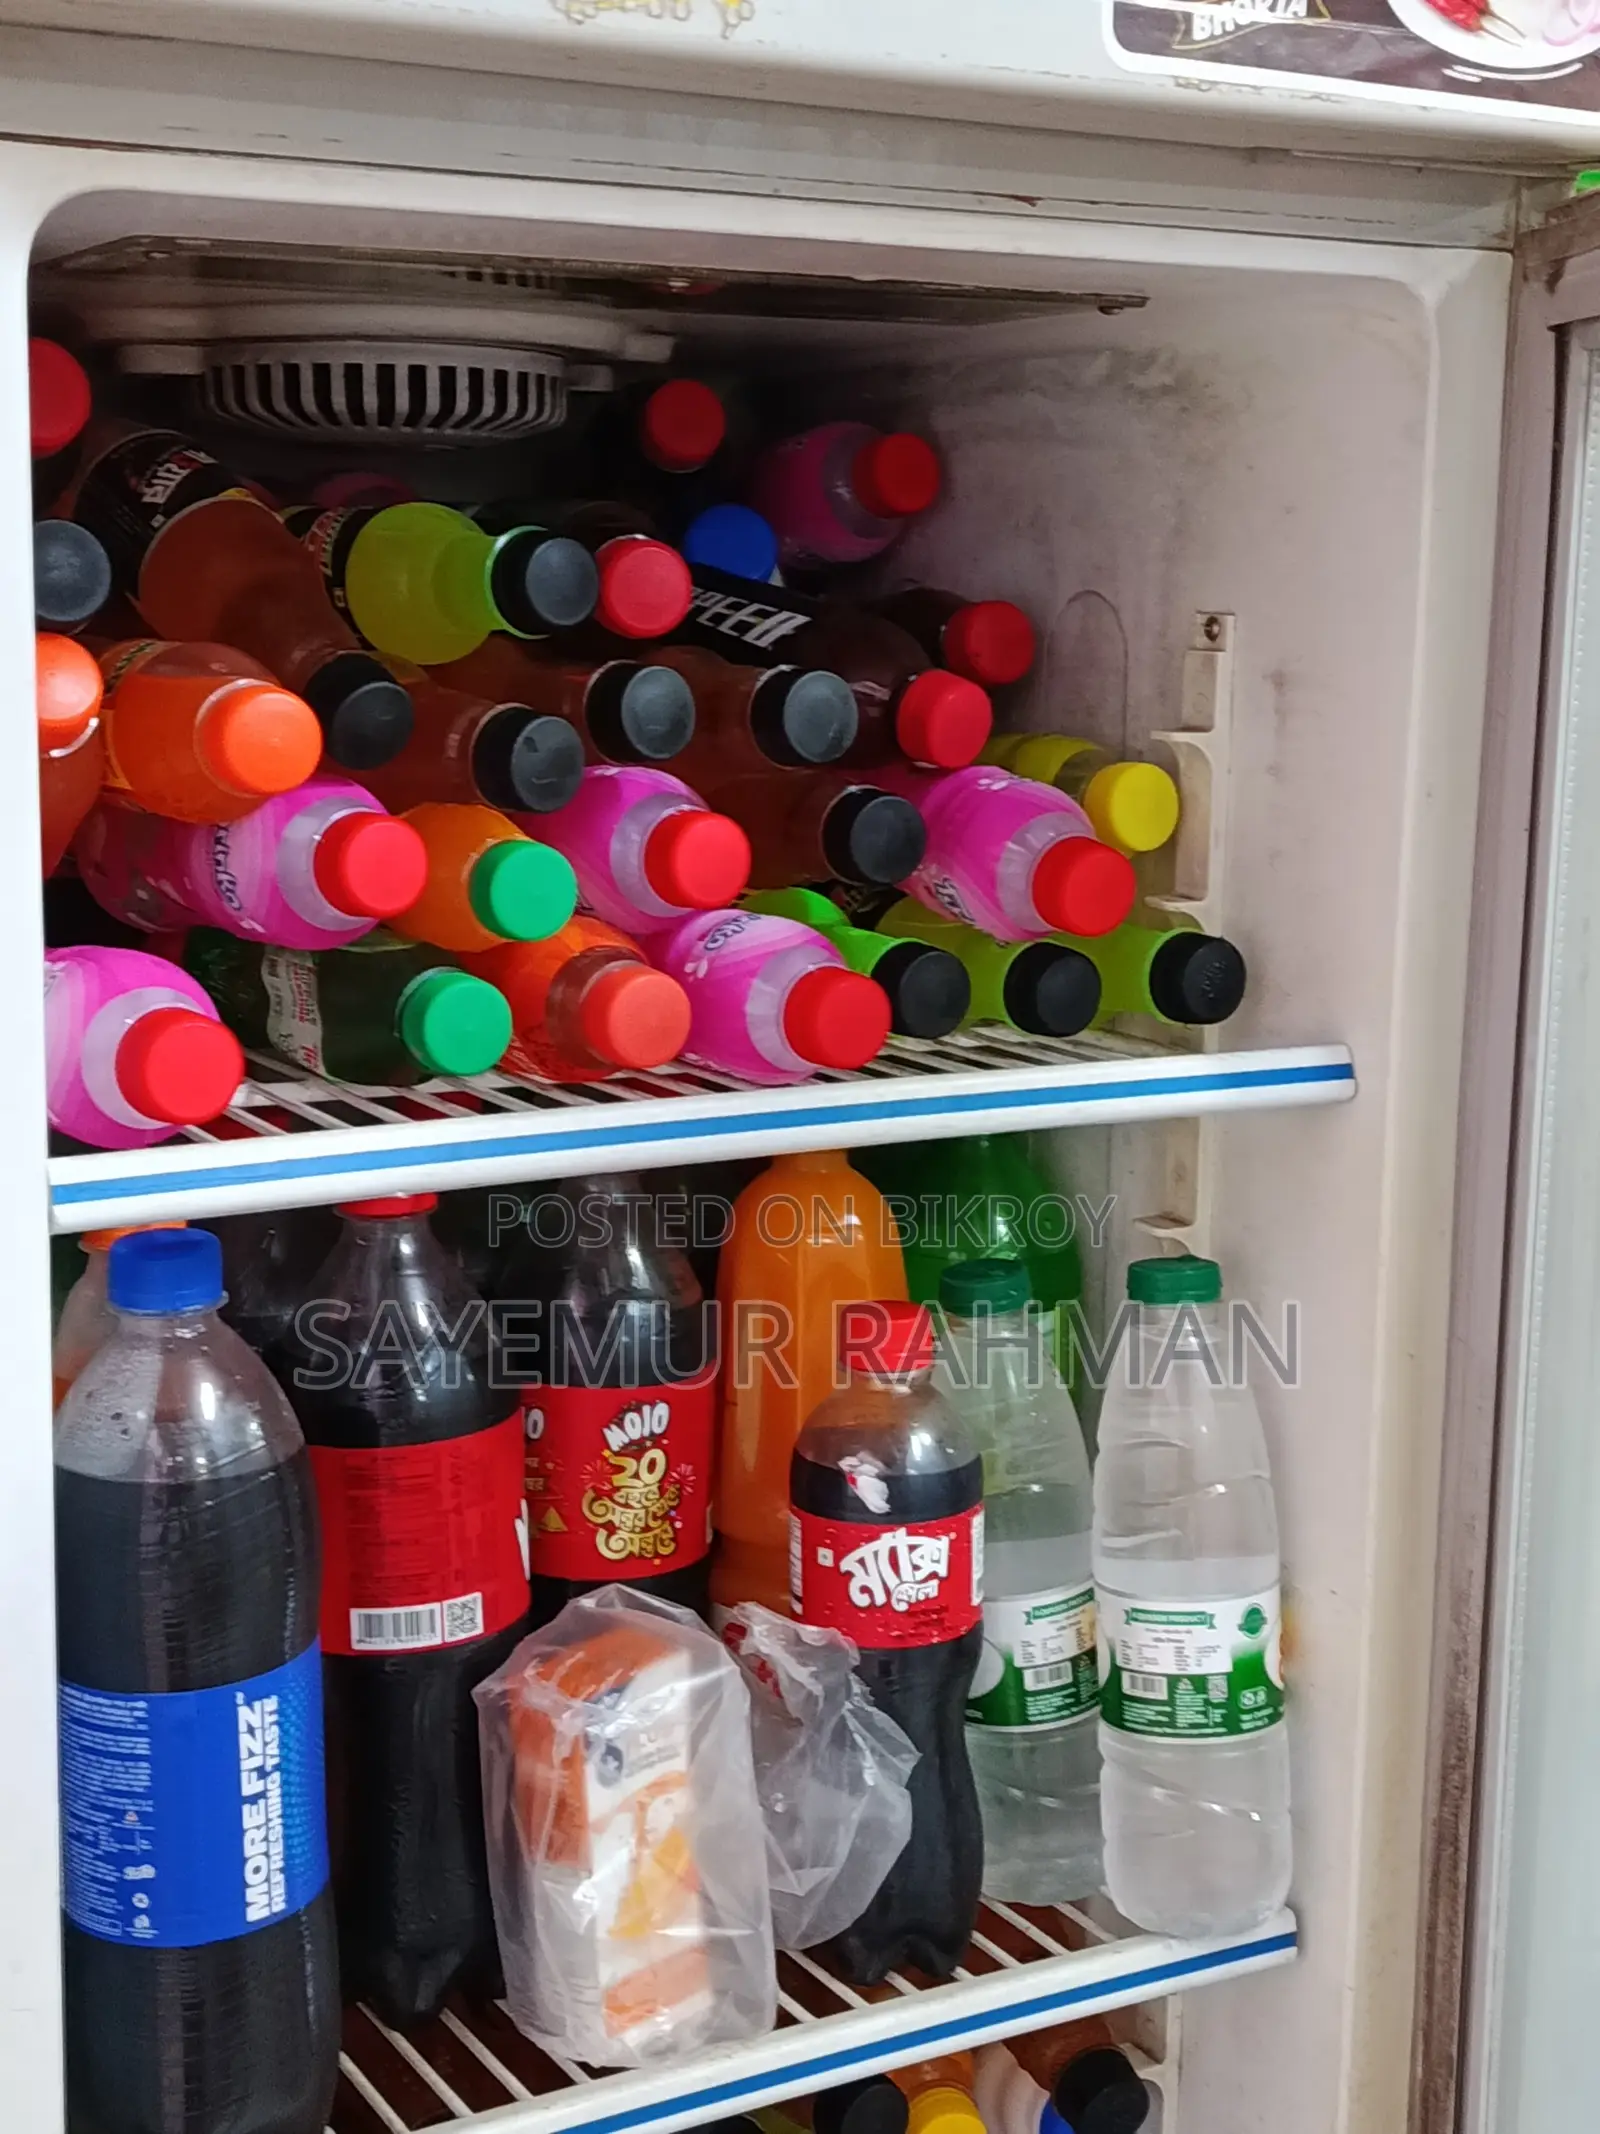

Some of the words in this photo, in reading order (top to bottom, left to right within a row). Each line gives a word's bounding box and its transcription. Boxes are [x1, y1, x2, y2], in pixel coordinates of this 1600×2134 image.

[602, 1402, 670, 1452] MOJO
[237, 1700, 266, 1797] FIZZ
[262, 1694, 281, 1773] TASTE
[242, 1797, 271, 1923] MORE
[265, 1770, 288, 1914] REFRESHING
